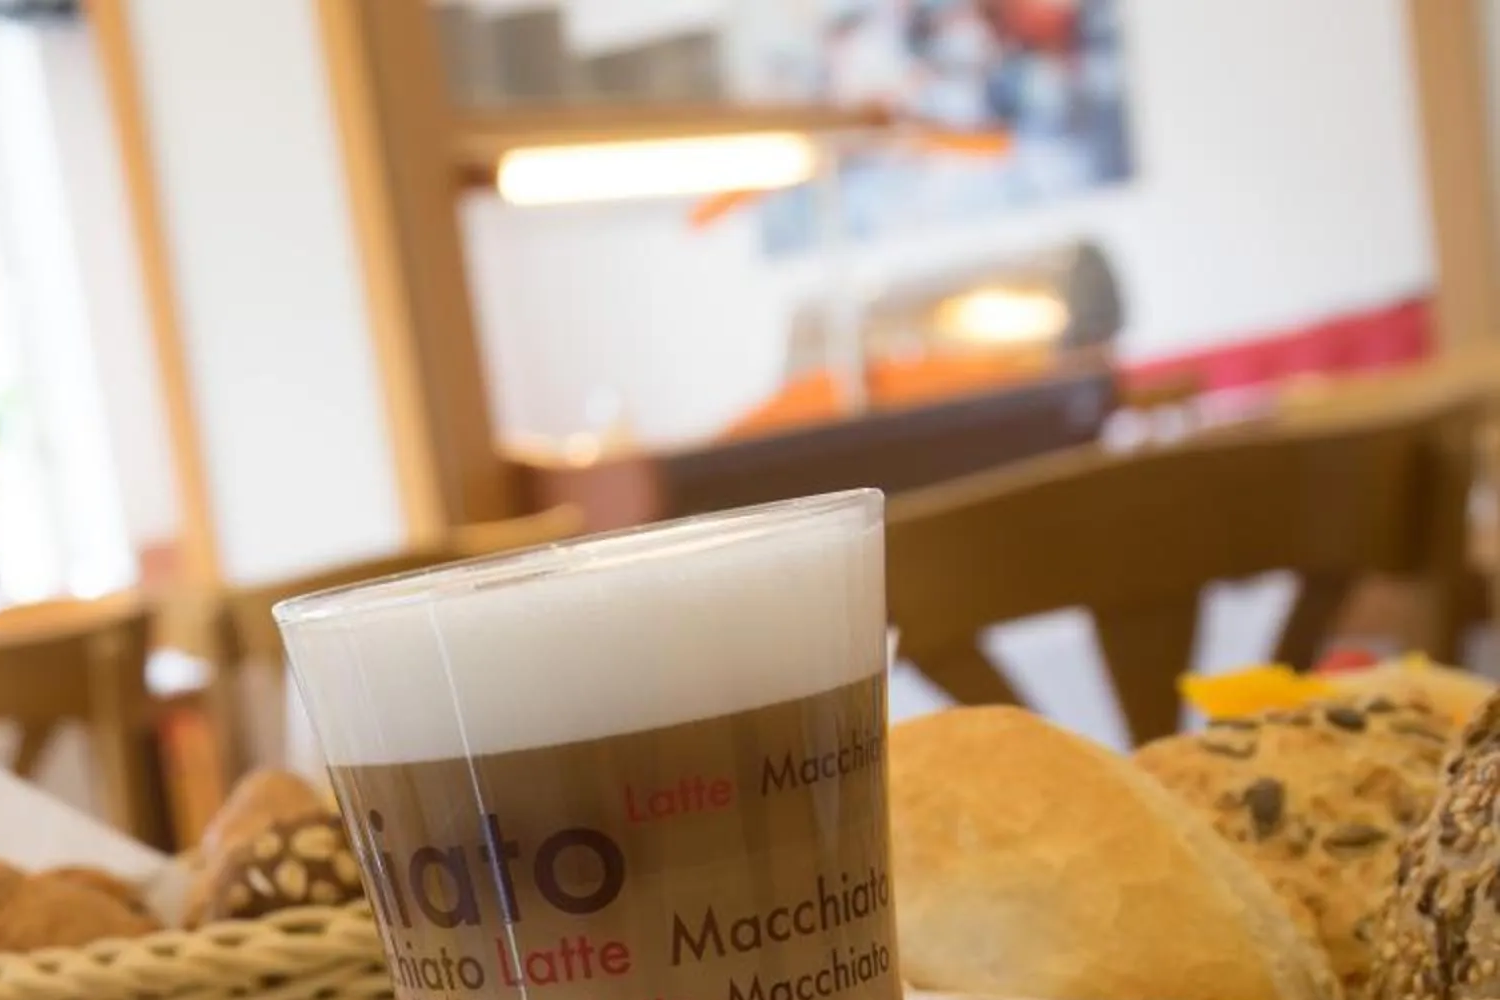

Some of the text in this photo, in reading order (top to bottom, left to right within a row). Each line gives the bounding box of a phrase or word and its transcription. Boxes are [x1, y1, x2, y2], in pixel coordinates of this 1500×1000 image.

[625, 727, 882, 823] Latte Macchia
[368, 808, 626, 929] iato
[495, 866, 889, 988] Latte Macchiato
